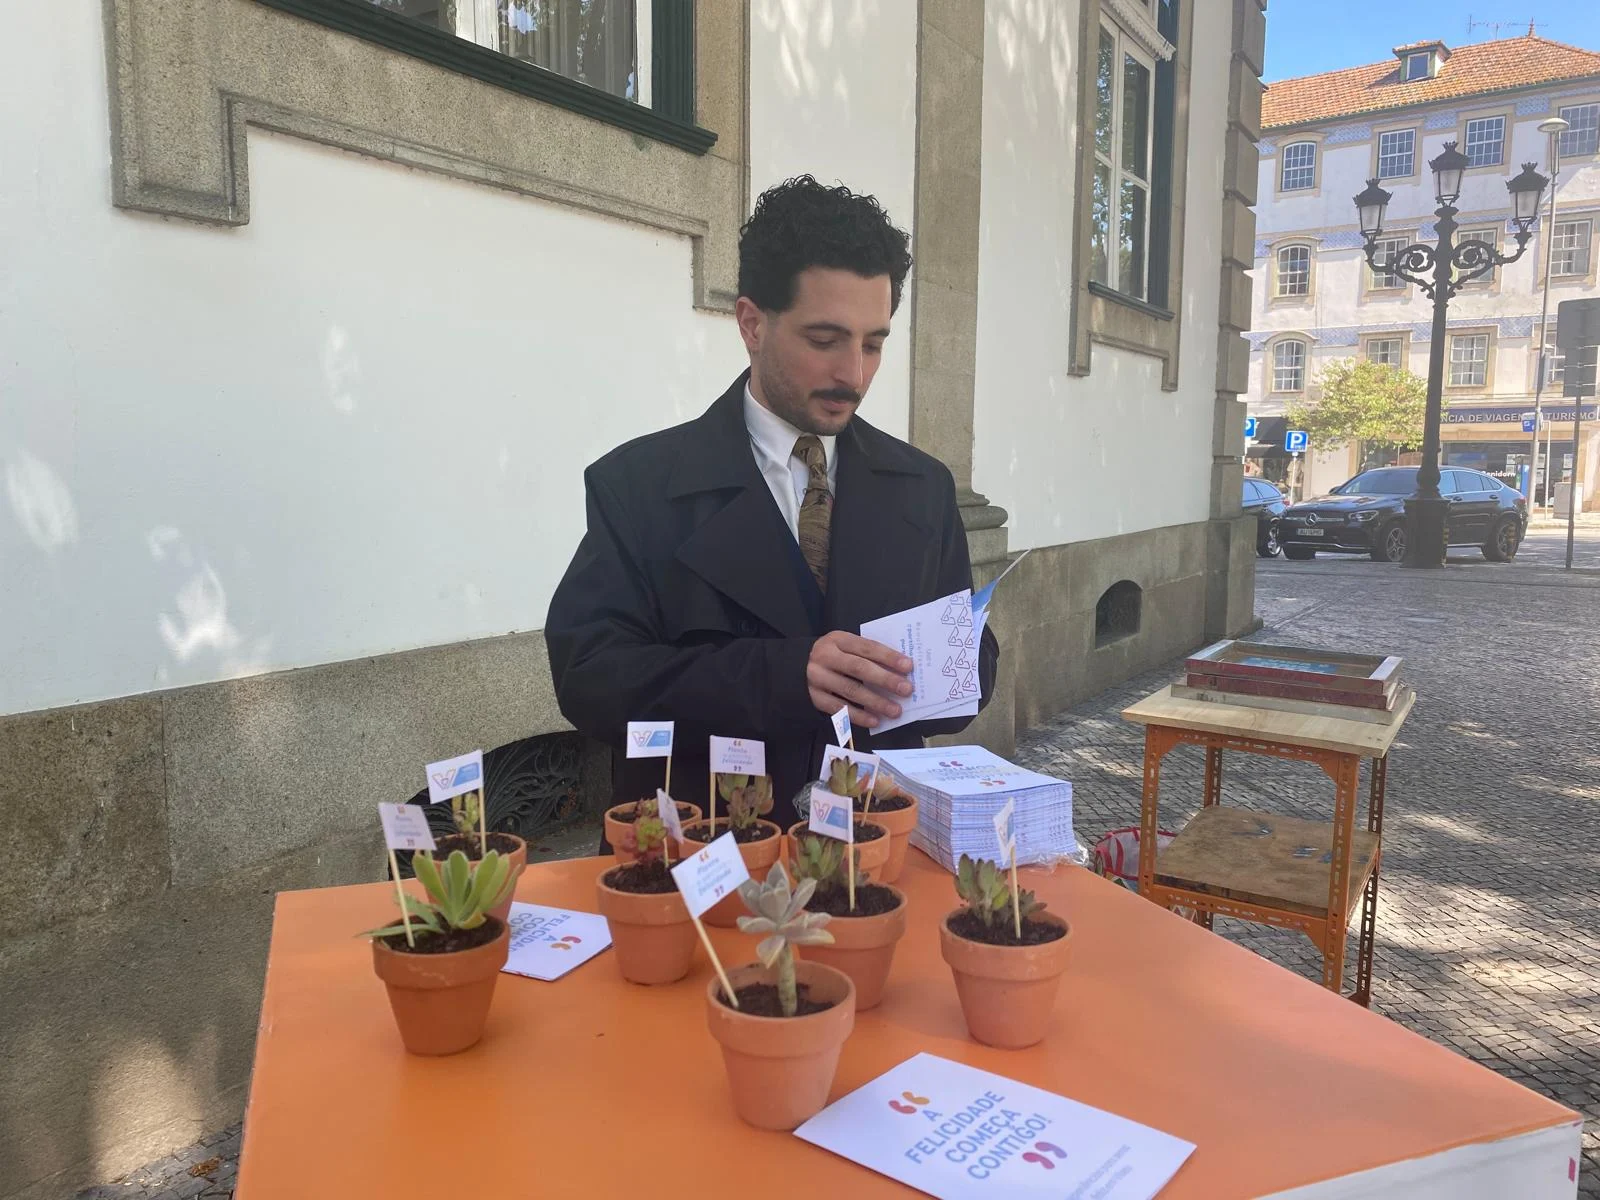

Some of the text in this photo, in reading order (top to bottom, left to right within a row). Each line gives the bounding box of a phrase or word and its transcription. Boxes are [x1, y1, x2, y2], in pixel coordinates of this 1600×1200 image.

[1468, 414, 1482, 423] DE
[1485, 413, 1522, 422] VIAGEN
[1290, 433, 1304, 449] P
[509, 912, 571, 952] FELICIDA
[904, 1090, 1006, 1165] FELICIDADE
[922, 1108, 943, 1122] A
[945, 1108, 1022, 1163] COMEÇA
[967, 1112, 1053, 1180] CONTIGO!
